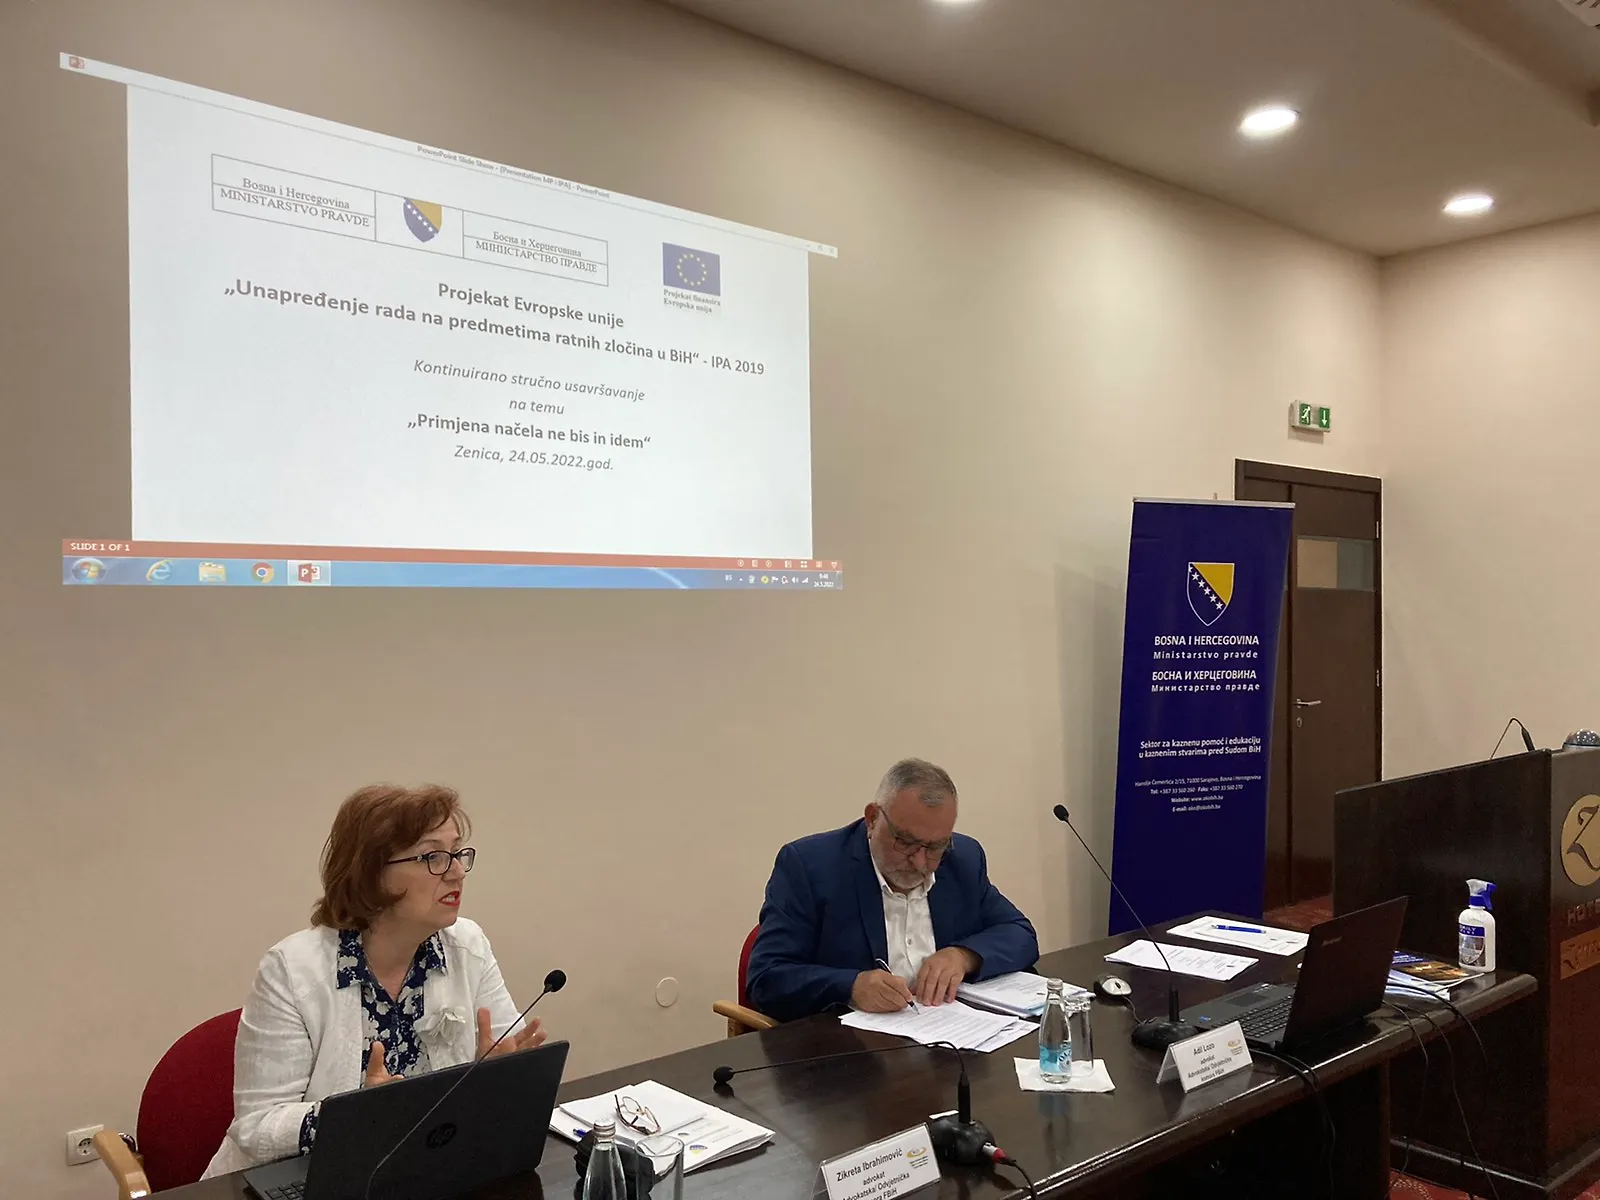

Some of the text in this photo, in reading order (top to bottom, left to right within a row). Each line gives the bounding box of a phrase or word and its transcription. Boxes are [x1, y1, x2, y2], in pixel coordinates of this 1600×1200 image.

[220, 187, 370, 227] MINISTARSTVO PRAVDE
[242, 177, 350, 210] Bosna i Hercegovina
[475, 240, 598, 273] МИНИСТАРСТВО ПРАВДЕ
[493, 231, 582, 258] Босна и Херцеговина
[438, 282, 624, 329] Projekat Evropske unije
[224, 279, 370, 316] „Unapređenje
[375, 305, 416, 321] rada
[421, 311, 443, 325] na
[448, 315, 551, 342] predmetima
[555, 331, 600, 350] ratnih
[604, 338, 654, 359] zločina
[657, 348, 666, 360] u
[711, 355, 732, 371] IPA
[735, 359, 765, 376] 2019
[413, 359, 645, 403] Kontinuirano stručno usavršavanje
[509, 400, 565, 415] na temu
[407, 413, 651, 449] „Primjena načela ne bis in idem“
[454, 445, 614, 472] Zenica, 24.05.2022.god.
[71, 542, 130, 552] SLIDE 1 OF 1
[1154, 635, 1260, 646] BOSNA I HERCEGOVINA
[1153, 650, 1259, 660] Ministarstvo pravde
[1151, 683, 1260, 693] Министарство правде
[1152, 670, 1257, 681] БОСНА И ХЕРЦЕГОВИНА
[1140, 740, 1161, 749] Sektor
[1172, 738, 1200, 747] kaznenu
[1201, 738, 1224, 747] pomoć
[1229, 736, 1261, 745] edukaciju
[1144, 749, 1177, 758] kaznenim
[1178, 748, 1207, 757] stvarima
[1208, 747, 1224, 756] pred
[1225, 746, 1248, 754] Sudom
[1248, 745, 1261, 753] BiH
[836, 1165, 862, 1182] Zikreta
[862, 1148, 903, 1171] Ibrahimović
[863, 1171, 886, 1186] advokat
